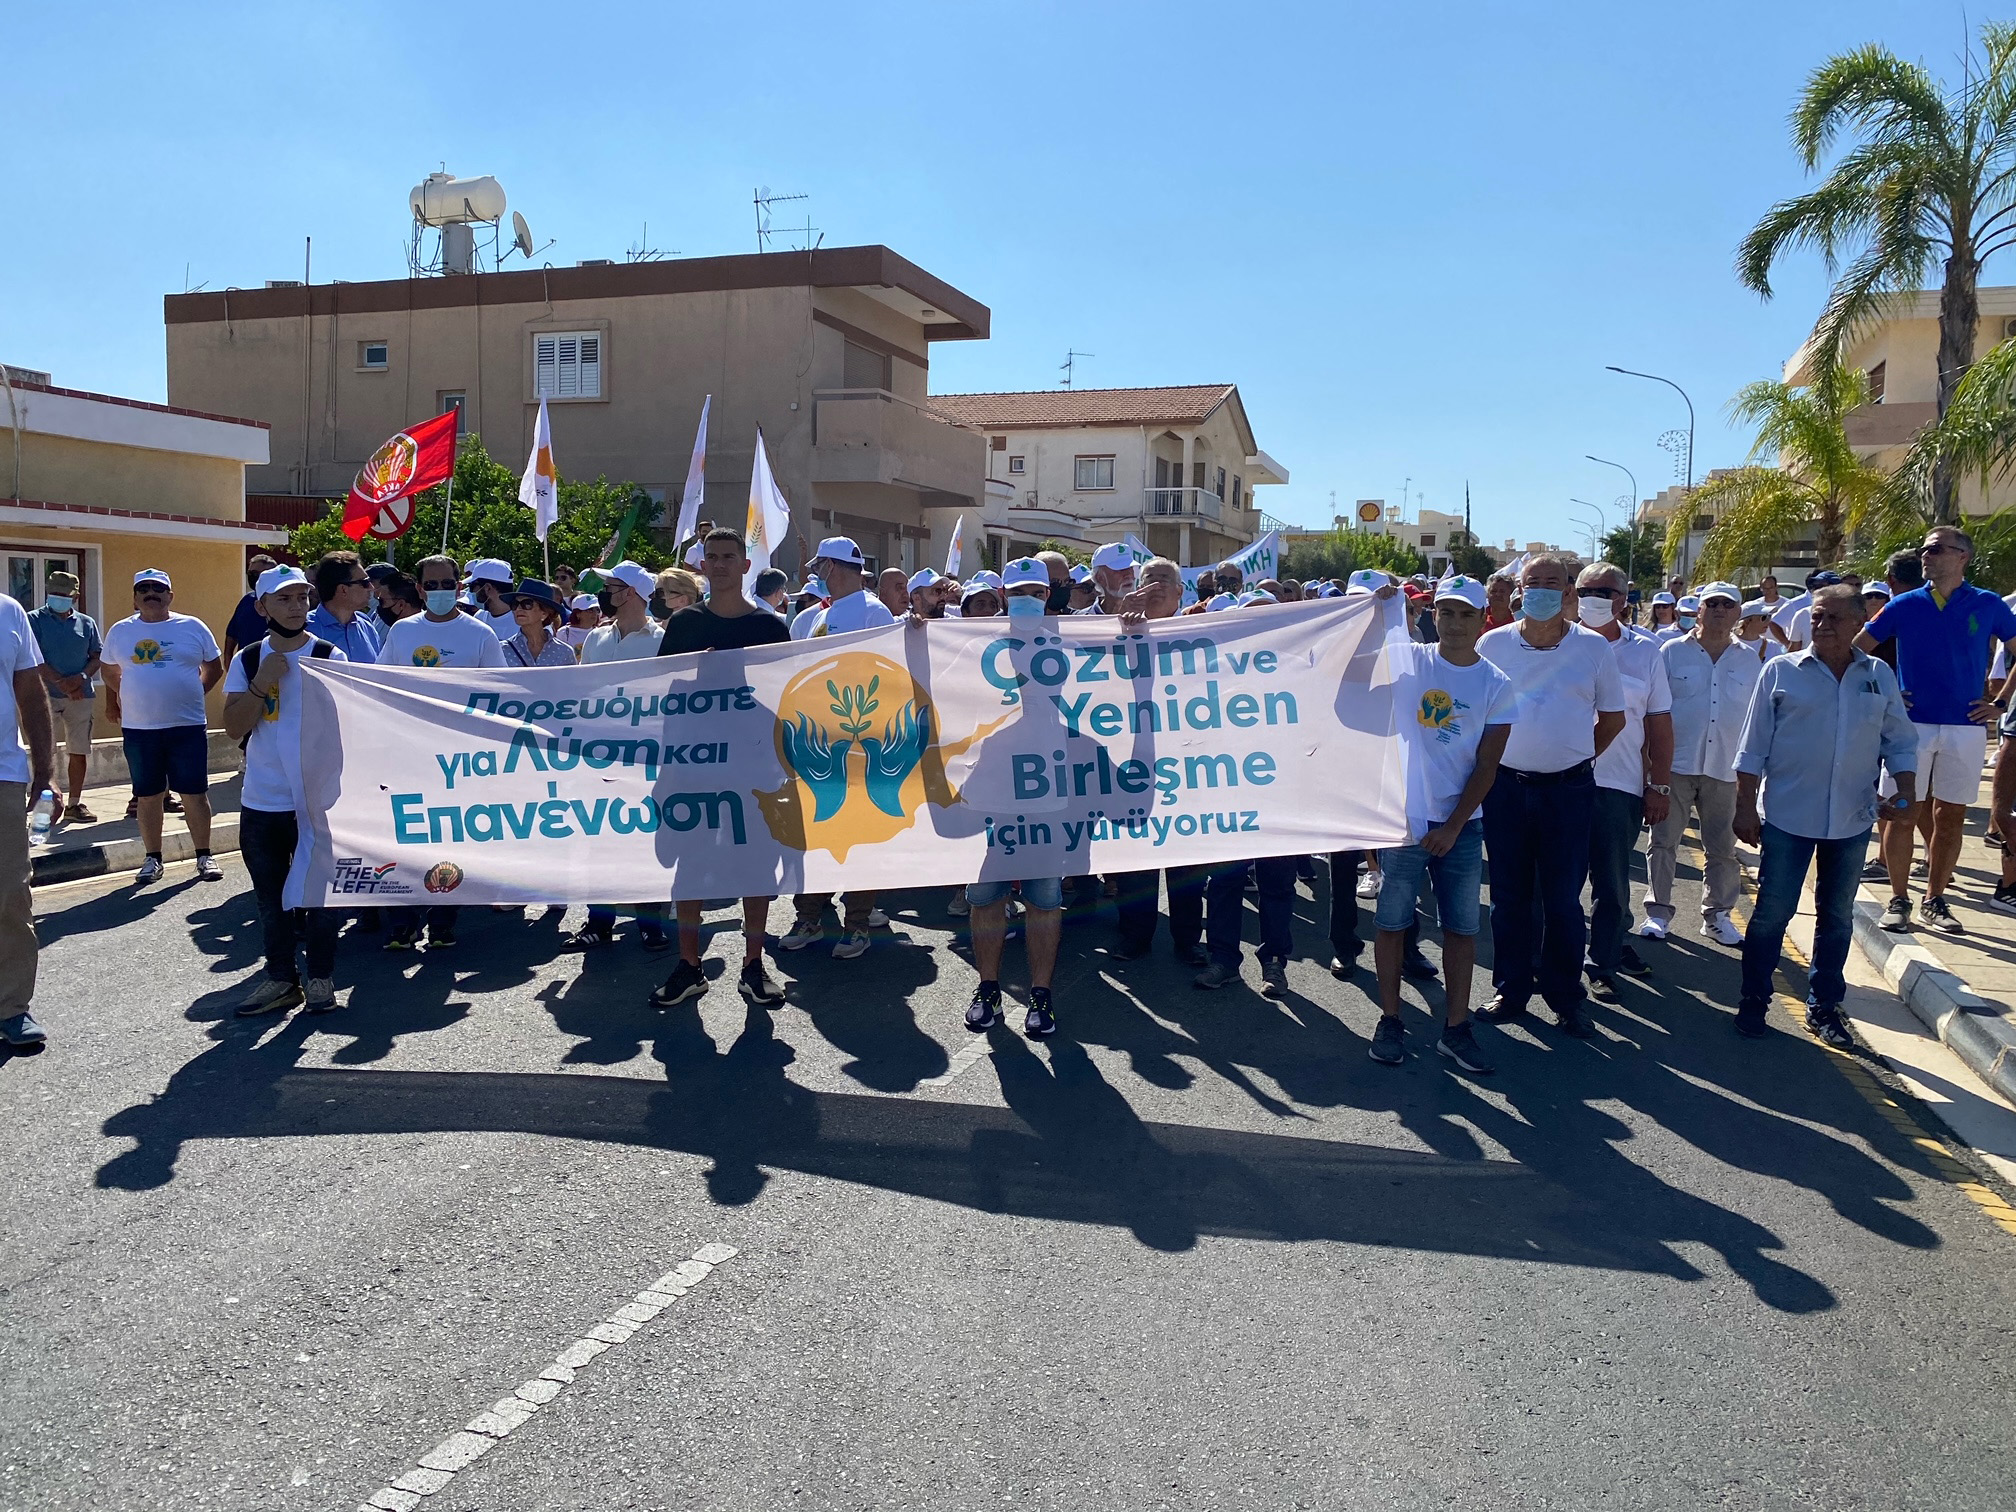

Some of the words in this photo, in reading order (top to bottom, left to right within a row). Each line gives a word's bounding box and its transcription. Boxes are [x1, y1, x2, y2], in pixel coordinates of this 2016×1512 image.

[981, 634, 1219, 705] Çözüm
[1225, 649, 1278, 675] ve
[463, 685, 757, 726] Πορευόμαστε
[1048, 680, 1299, 738] Yeniden
[435, 750, 498, 789] για
[503, 724, 662, 782] Λύση
[662, 742, 729, 765] και
[1011, 745, 1277, 806] Birleşme
[390, 781, 748, 846] Επανένωση
[985, 815, 1052, 855] için
[1061, 808, 1260, 852] yürüyoruz
[332, 881, 380, 894] LEFT
[335, 866, 373, 879] THE
